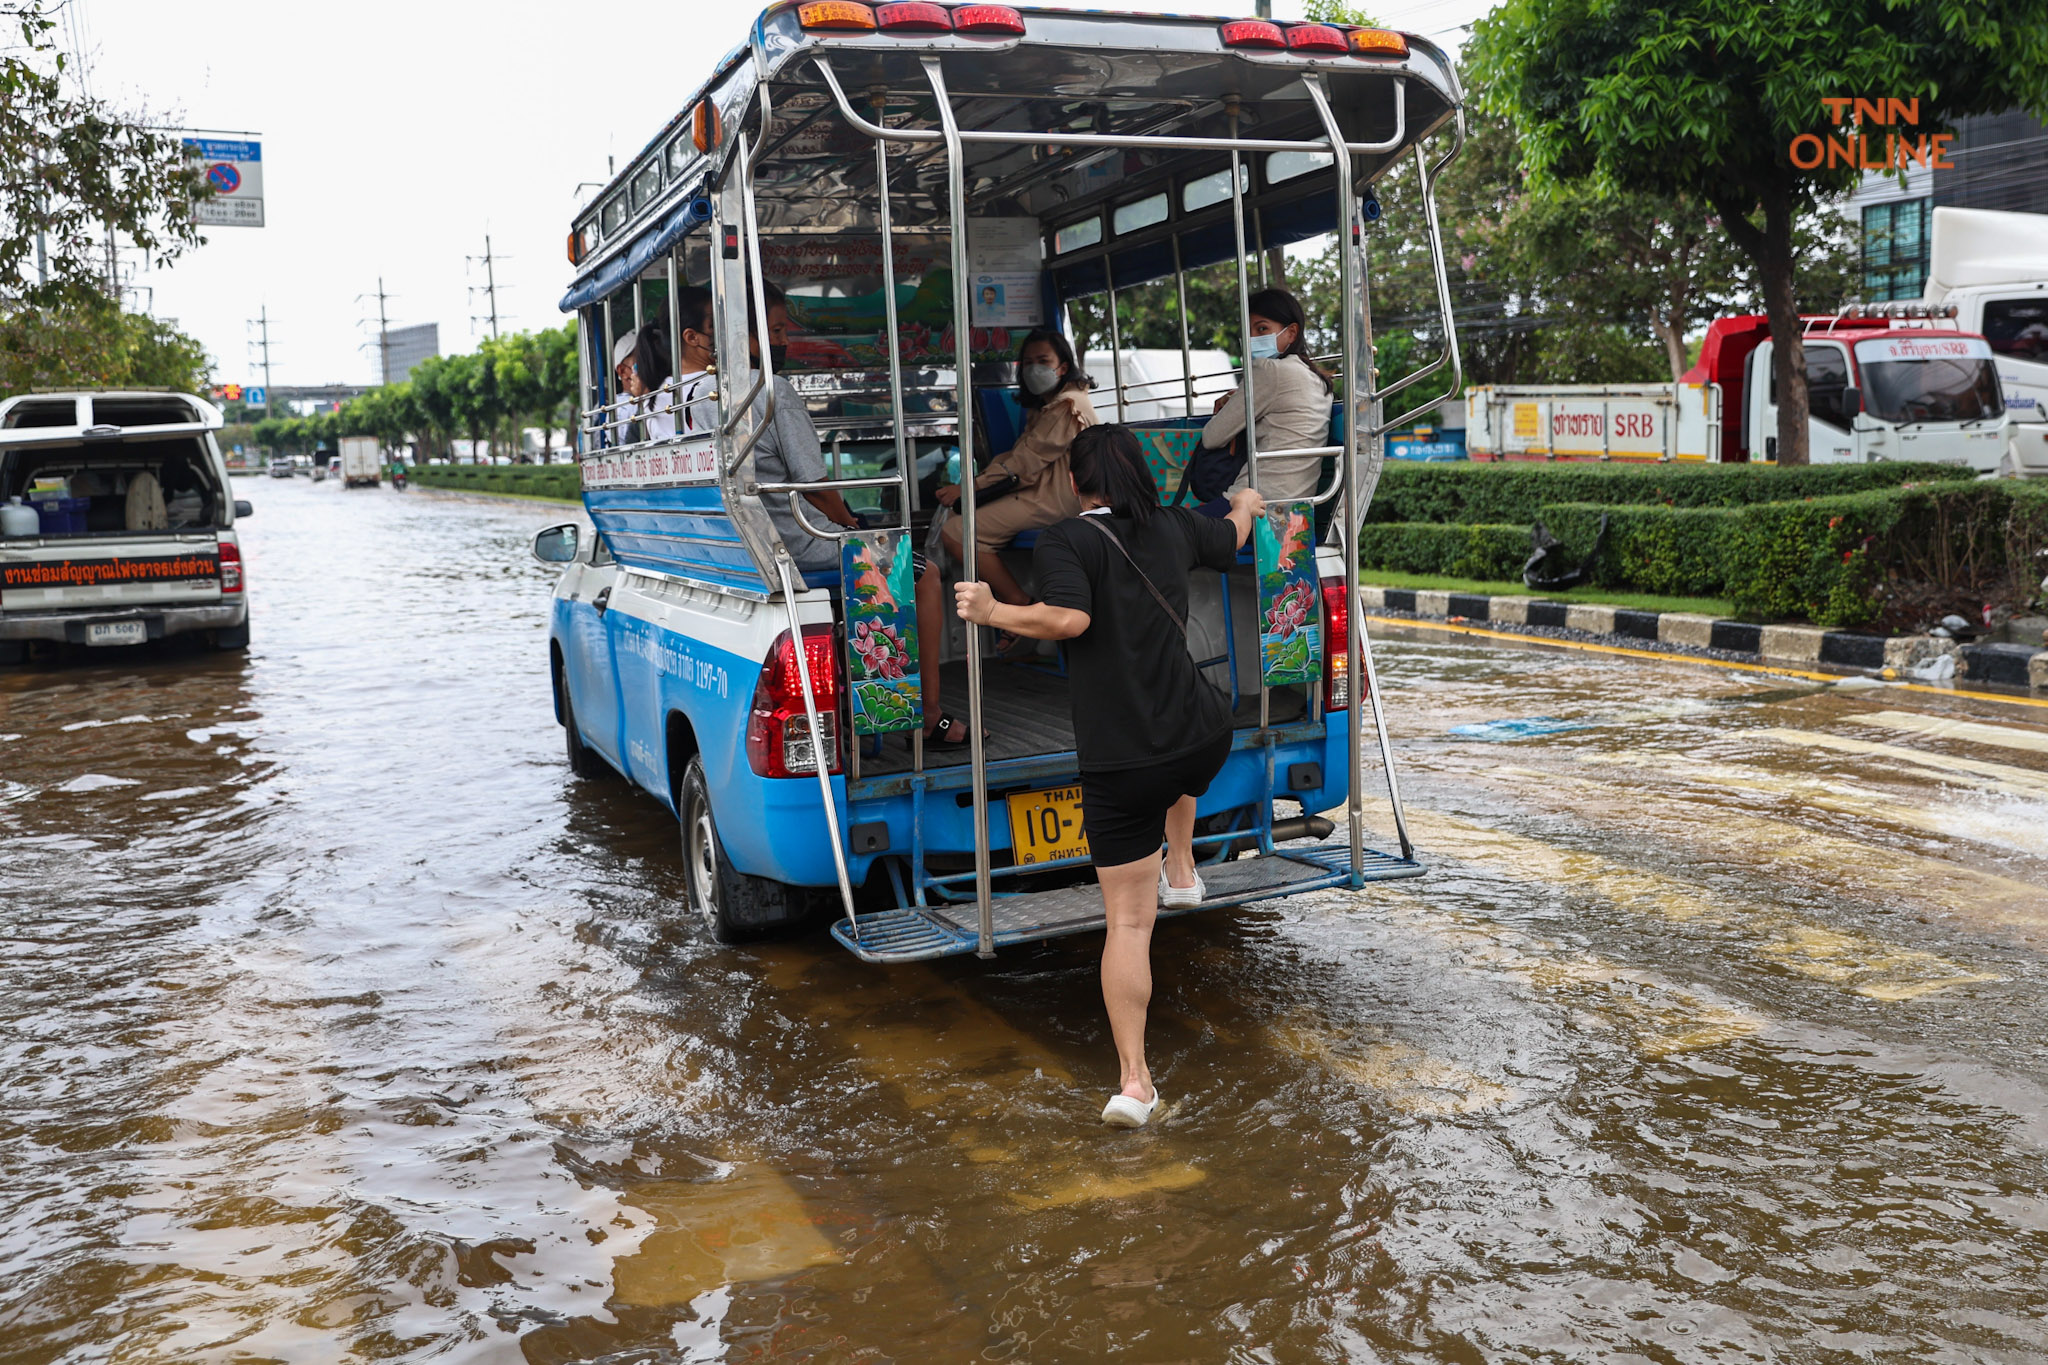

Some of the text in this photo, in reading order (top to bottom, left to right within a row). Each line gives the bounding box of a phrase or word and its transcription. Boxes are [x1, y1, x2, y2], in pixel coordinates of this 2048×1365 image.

[1615, 413, 1653, 438] SRB
[4, 556, 216, 587] งานซ่อมสัญญาณไฟจราจรเร่งด่วน
[695, 659, 728, 699] 1197-70
